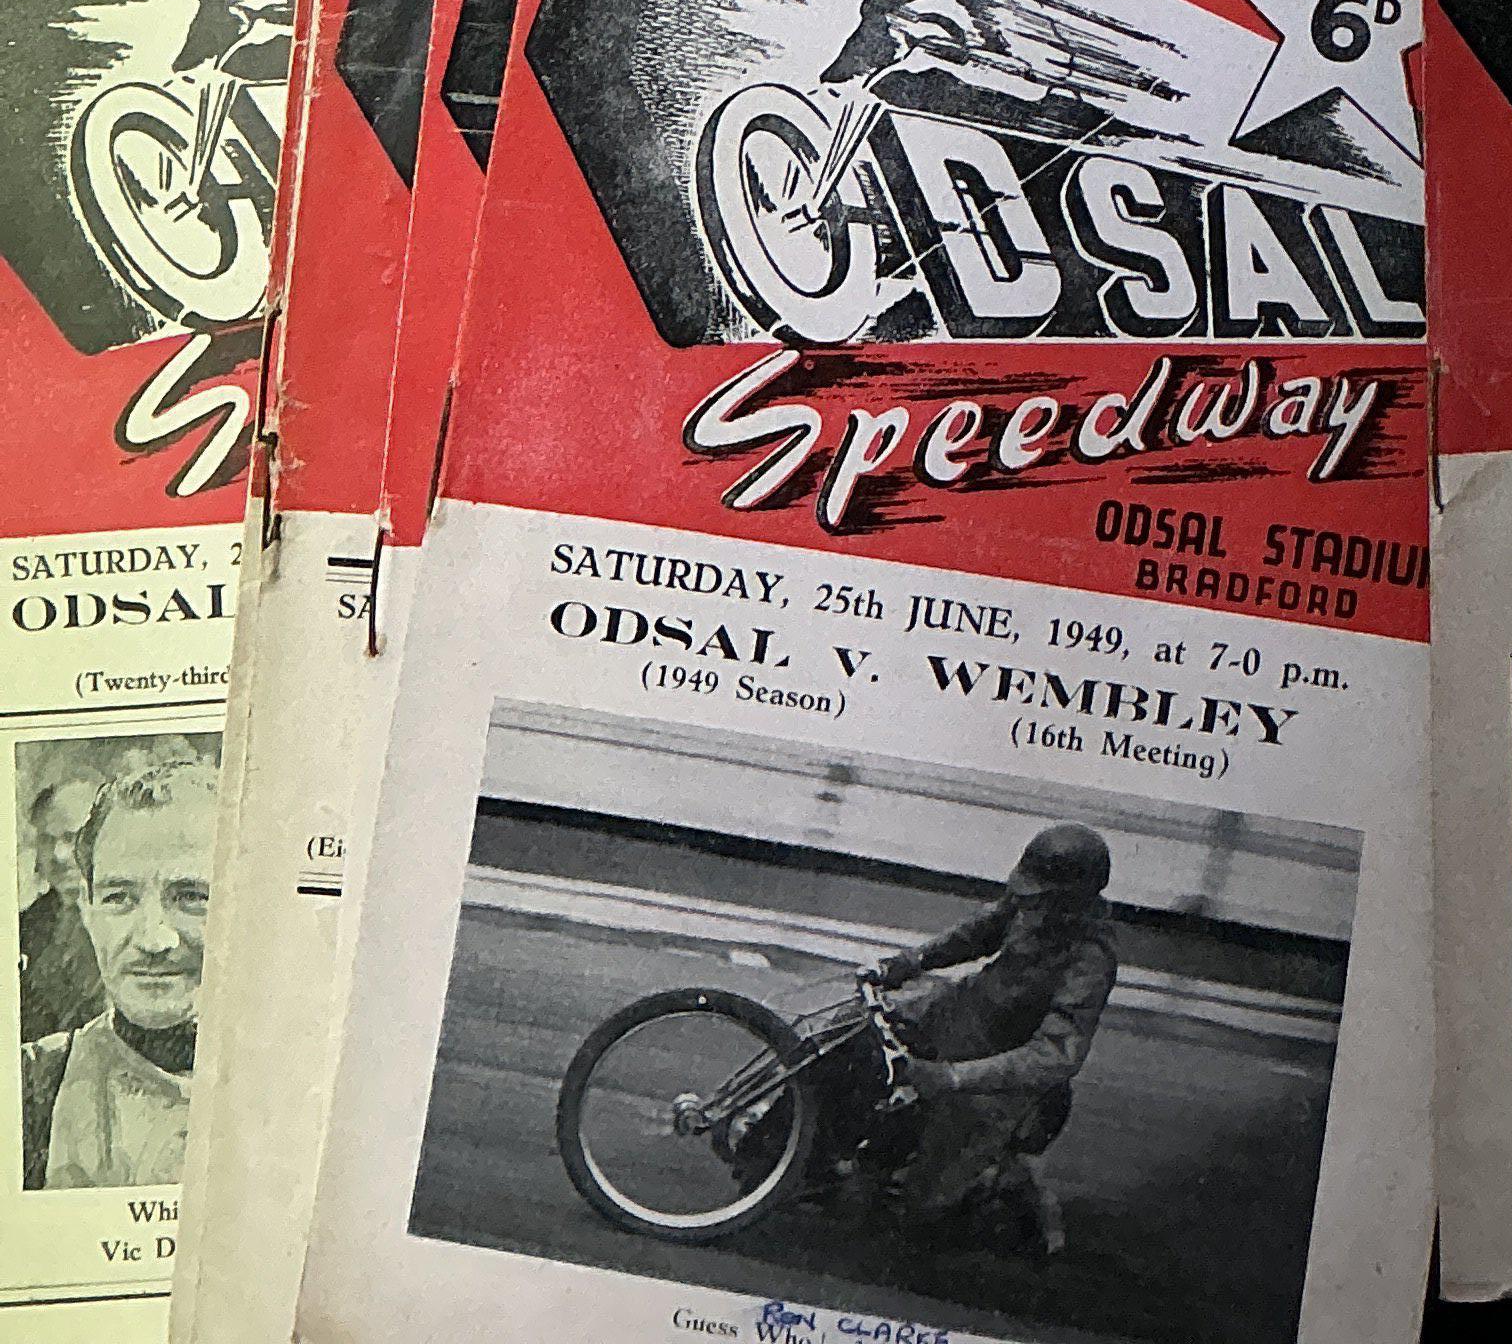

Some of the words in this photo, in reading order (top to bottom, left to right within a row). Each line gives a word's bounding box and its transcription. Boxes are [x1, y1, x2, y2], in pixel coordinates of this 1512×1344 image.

[684, 349, 1382, 532] Speedway
[1094, 499, 1227, 558] ODSAL
[11, 543, 209, 581] SATURDAY,
[1135, 558, 1359, 620] BRADFORD
[12, 584, 236, 633] ODSAL
[549, 543, 790, 609] SATURDAY,
[813, 582, 884, 620] 25th
[903, 594, 1020, 646] JUNE,
[1047, 616, 1130, 661] 1949,
[1153, 639, 1187, 665] at
[1280, 659, 1350, 691] p.m.
[549, 600, 791, 669] ODSAL
[926, 654, 1301, 746] WEMBLEY
[641, 660, 720, 693] (1949
[735, 675, 847, 721] Season)
[1010, 716, 1085, 753] (16th
[1101, 729, 1231, 780] Meeting)
[101, 1240, 141, 1262] Vic
[672, 1307, 740, 1339] Guess
